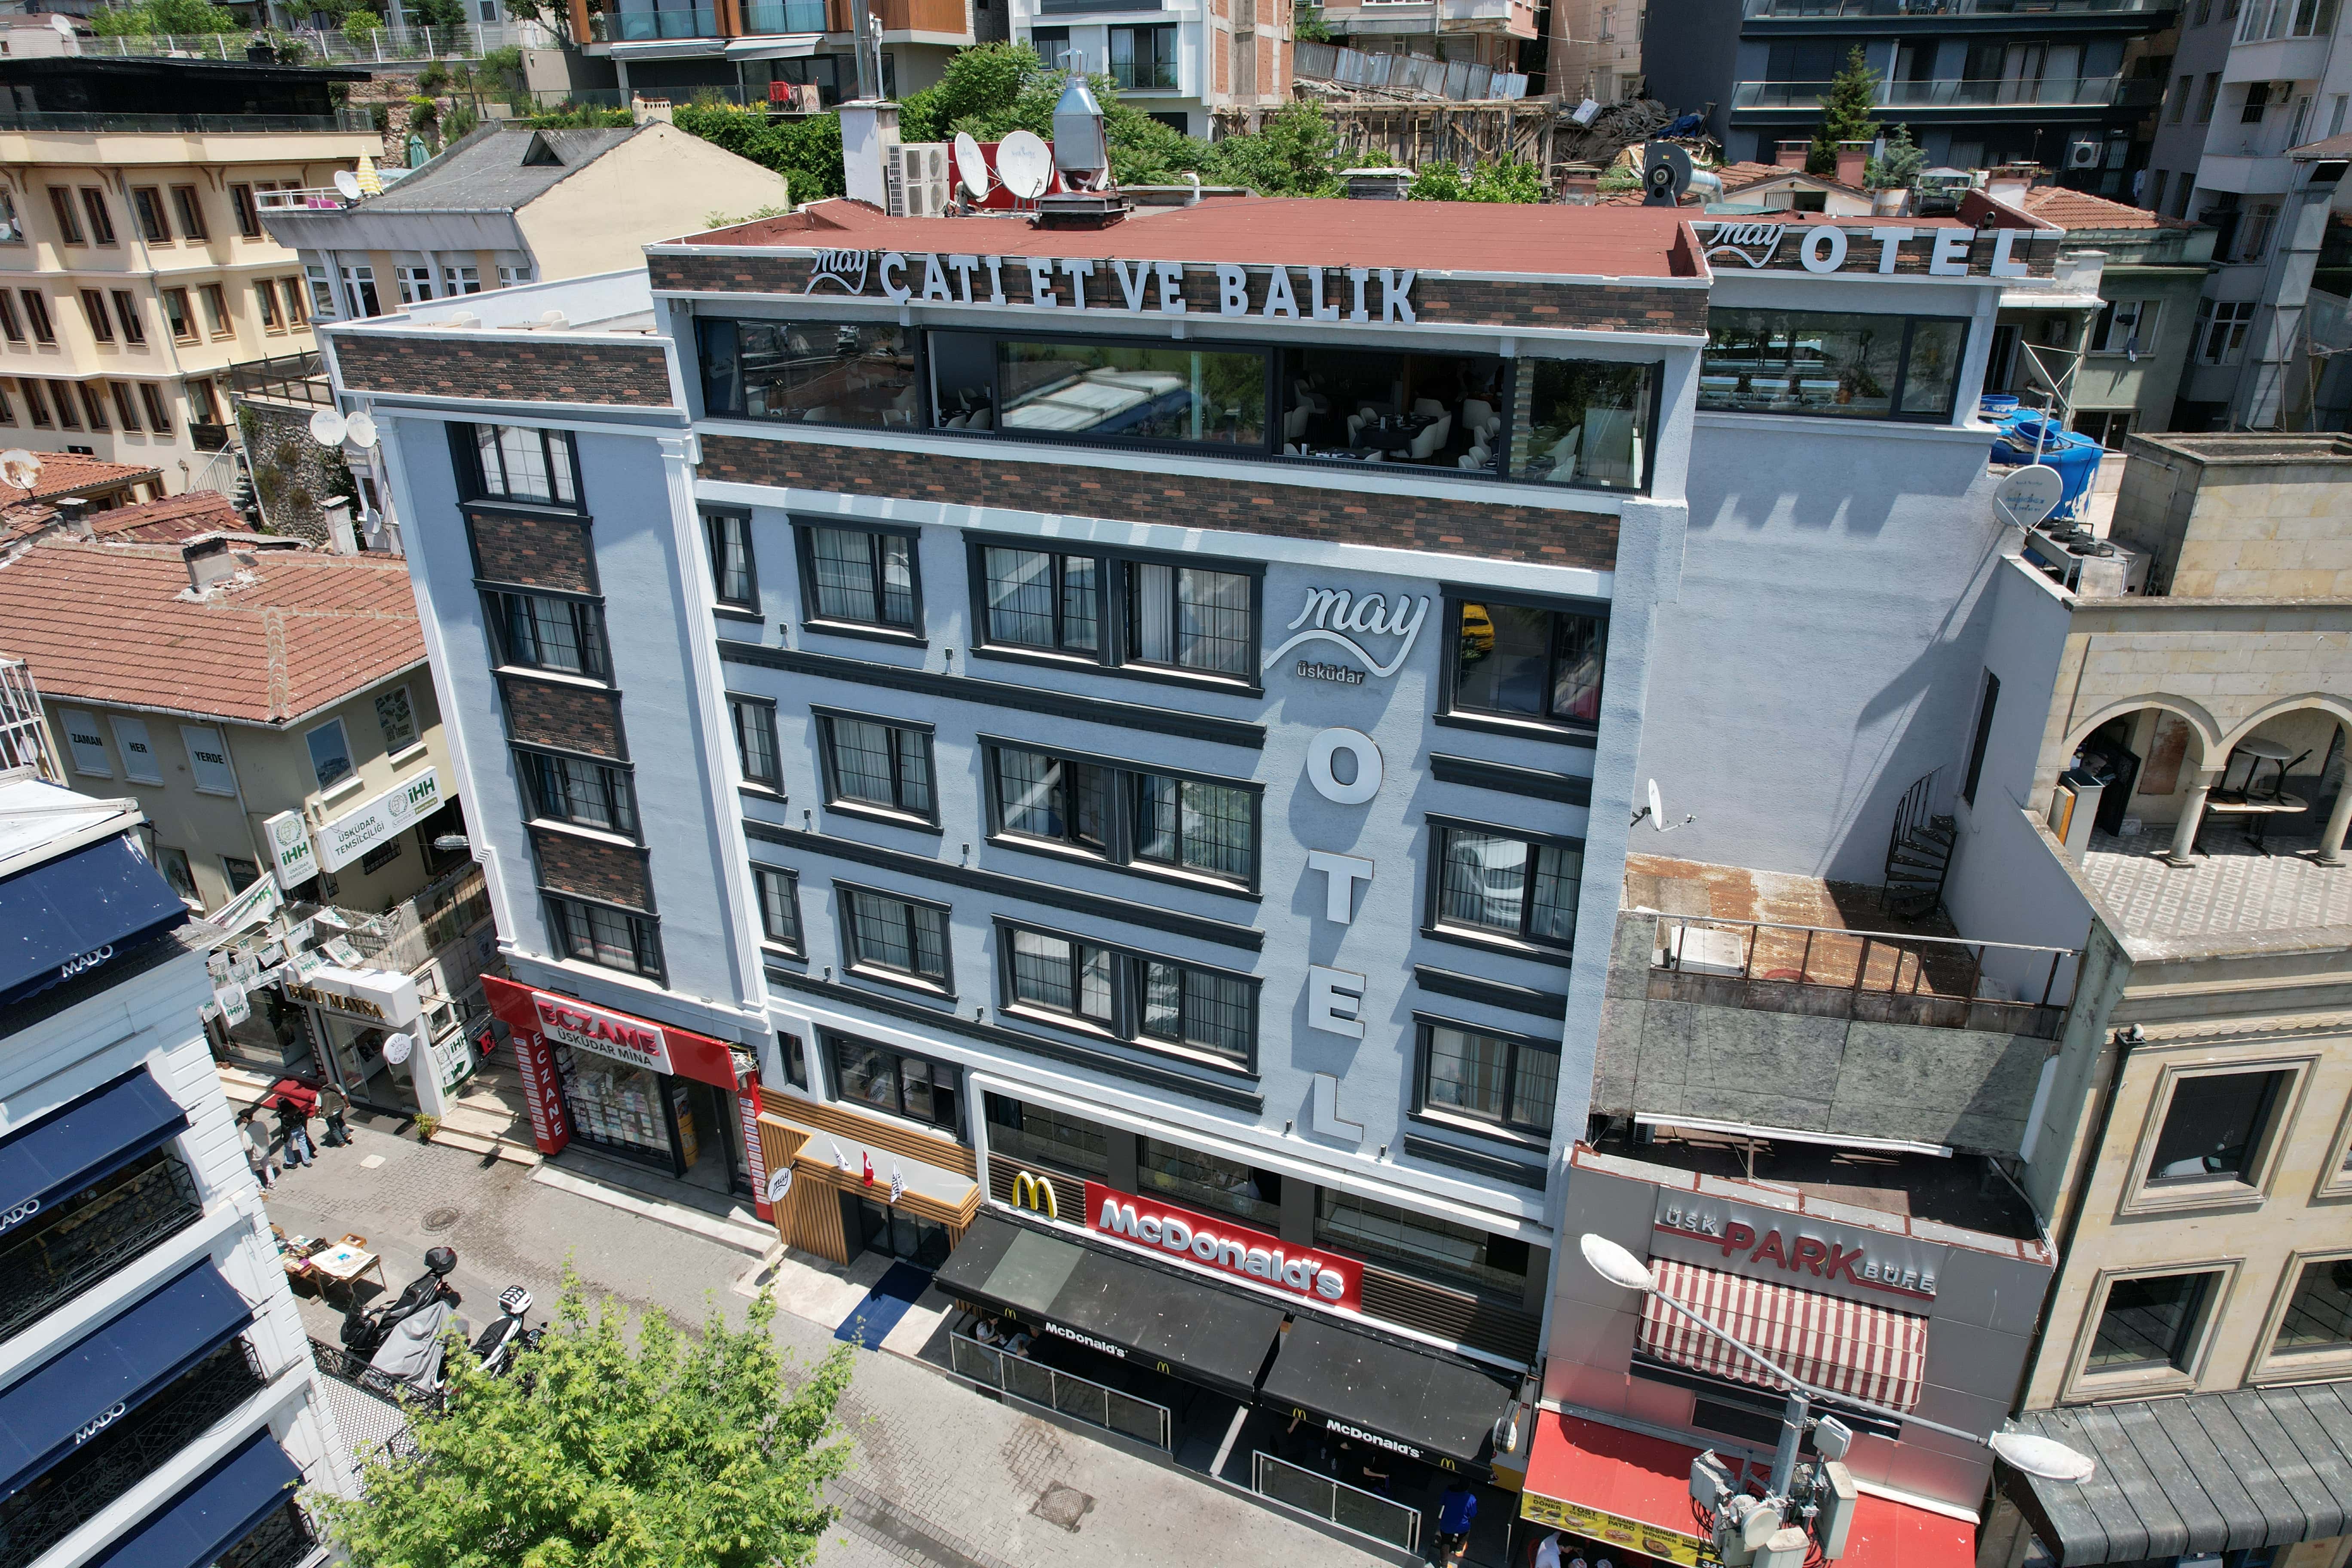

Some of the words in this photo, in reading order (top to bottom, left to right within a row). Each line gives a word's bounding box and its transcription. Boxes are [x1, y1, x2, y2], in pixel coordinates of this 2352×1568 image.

[1705, 222, 1787, 268] may
[1801, 225, 2029, 277] OTEL
[879, 252, 1006, 306] ÇATI
[1026, 257, 1094, 310] ET
[1115, 261, 1187, 315] VE
[1216, 264, 1417, 325] BALIK
[1264, 587, 1430, 678] may
[1296, 660, 1365, 685] üsküdar
[71, 733, 103, 747] ZAMAN
[129, 741, 148, 754] HER
[194, 750, 225, 765] YERDE
[335, 822, 385, 856] TEMSİLCİLİĞİ
[338, 816, 376, 842] ÜSKÜDAR
[289, 861, 309, 874] ÜSKÜDAR
[1307, 726, 1384, 1143] OTEL
[61, 944, 113, 978] MADO
[326, 991, 386, 1019] MAYSA
[536, 1000, 661, 1057] ECZANE
[557, 1027, 617, 1055] ÜSKÜDAR
[618, 1048, 653, 1067] MİNA
[533, 1031, 563, 1137] ECZANE
[0, 1199, 40, 1231] ADO
[1099, 1197, 1345, 1300] McDonald's
[1665, 1207, 1716, 1233] ÜSK
[1721, 1219, 1865, 1285] PARK
[1864, 1261, 1936, 1291] BÜFE
[1045, 1322, 1126, 1358] McDonald's
[75, 1401, 126, 1445] MADO
[1326, 1418, 1421, 1458] McDonald's
[1533, 1499, 1562, 1511] DÖNER
[1571, 1505, 1598, 1516] TOST
[1608, 1515, 1636, 1527] EFSANE
[1608, 1520, 1635, 1531] PATSO
[1642, 1530, 1677, 1544] MENEMEN
